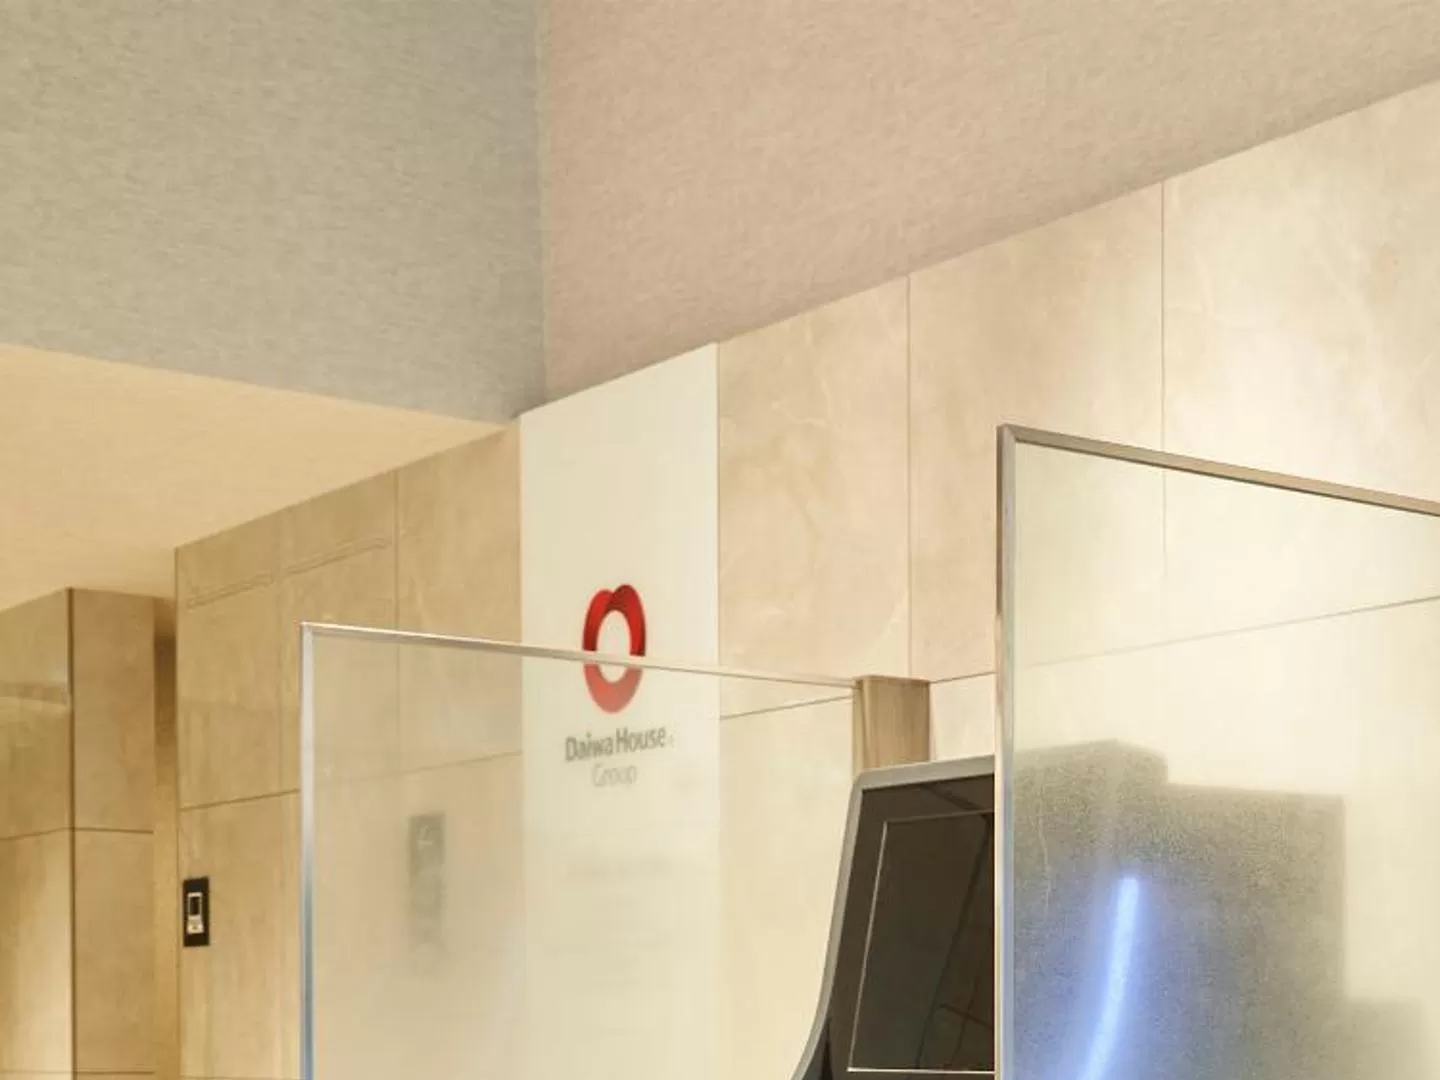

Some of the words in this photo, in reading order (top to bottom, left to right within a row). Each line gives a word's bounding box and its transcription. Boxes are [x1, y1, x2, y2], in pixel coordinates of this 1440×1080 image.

[565, 731, 613, 762] Daiwa
[616, 726, 666, 753] House
[592, 763, 638, 789] Group
